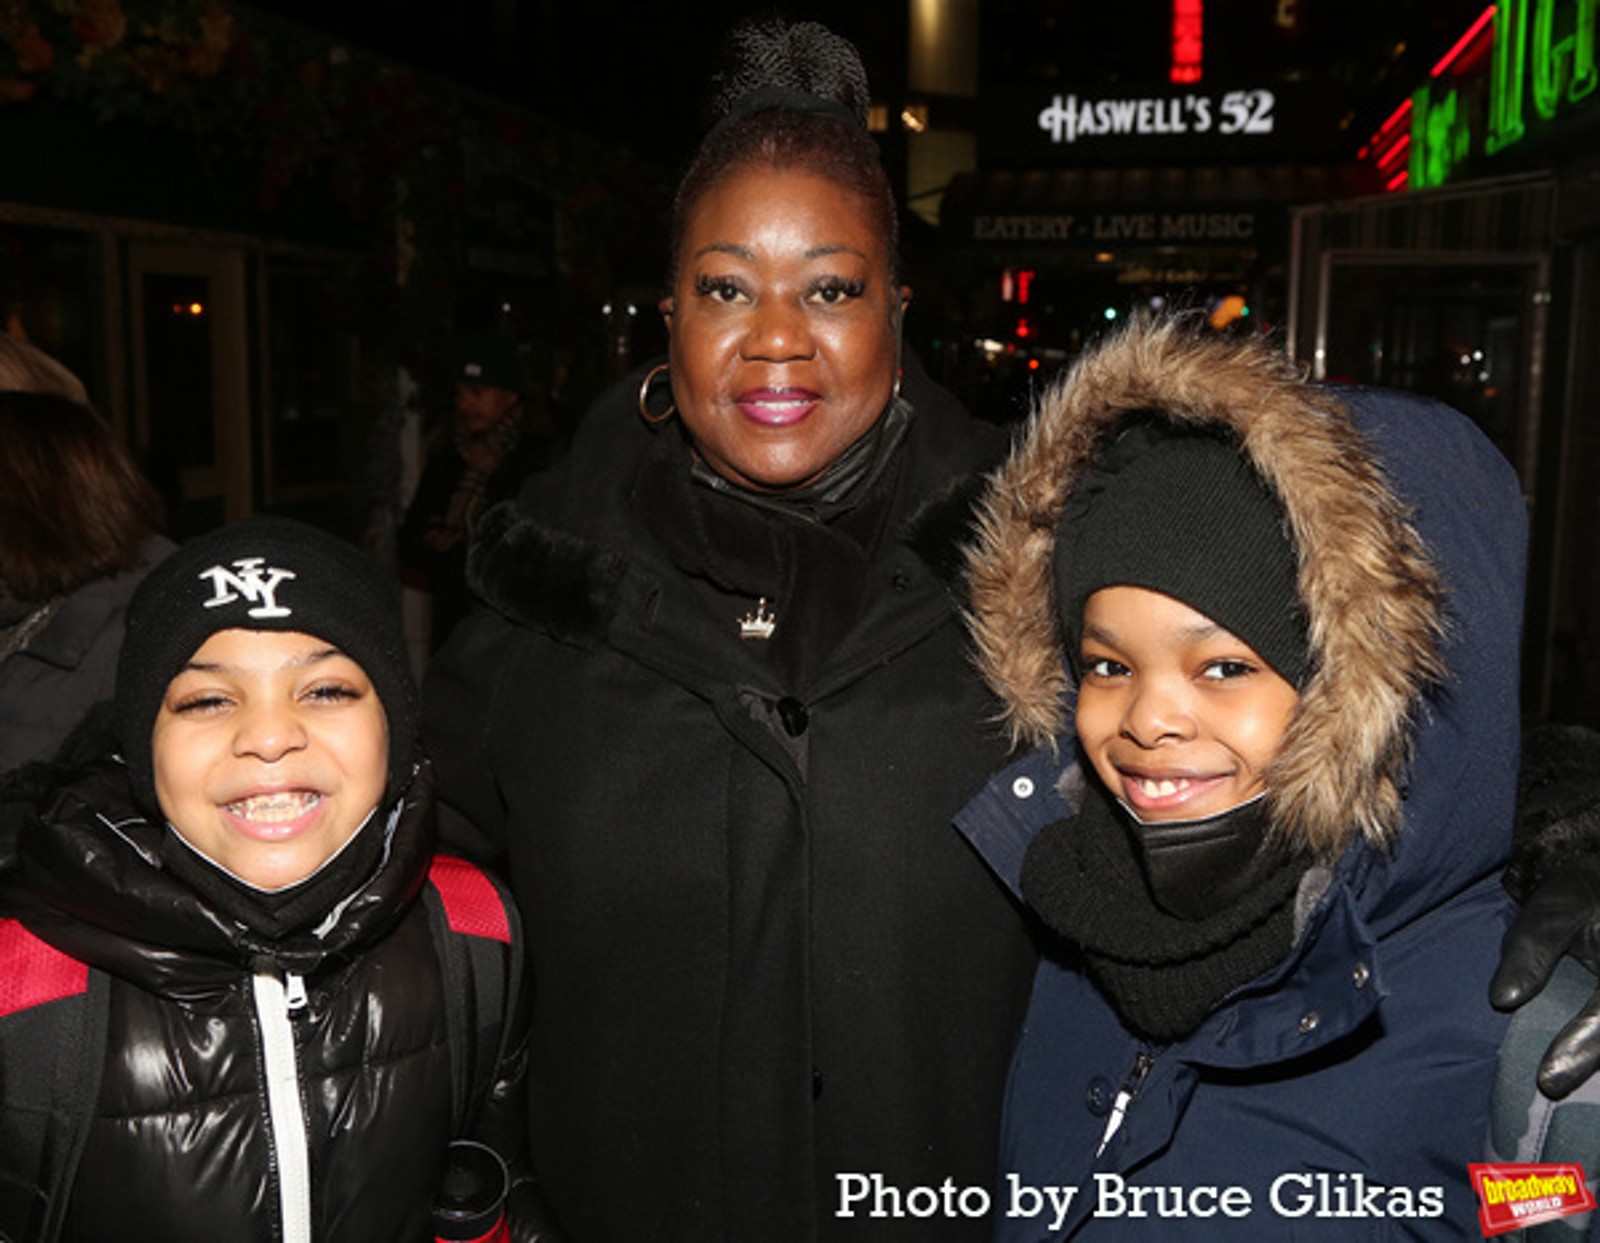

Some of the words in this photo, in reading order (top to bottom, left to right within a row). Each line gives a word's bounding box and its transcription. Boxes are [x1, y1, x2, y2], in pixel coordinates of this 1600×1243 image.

[1219, 89, 1275, 134] 52
[973, 215, 1073, 241] EATERY
[1093, 214, 1156, 241] LIVE
[1160, 213, 1254, 240] MUSIC
[198, 557, 297, 618] NY
